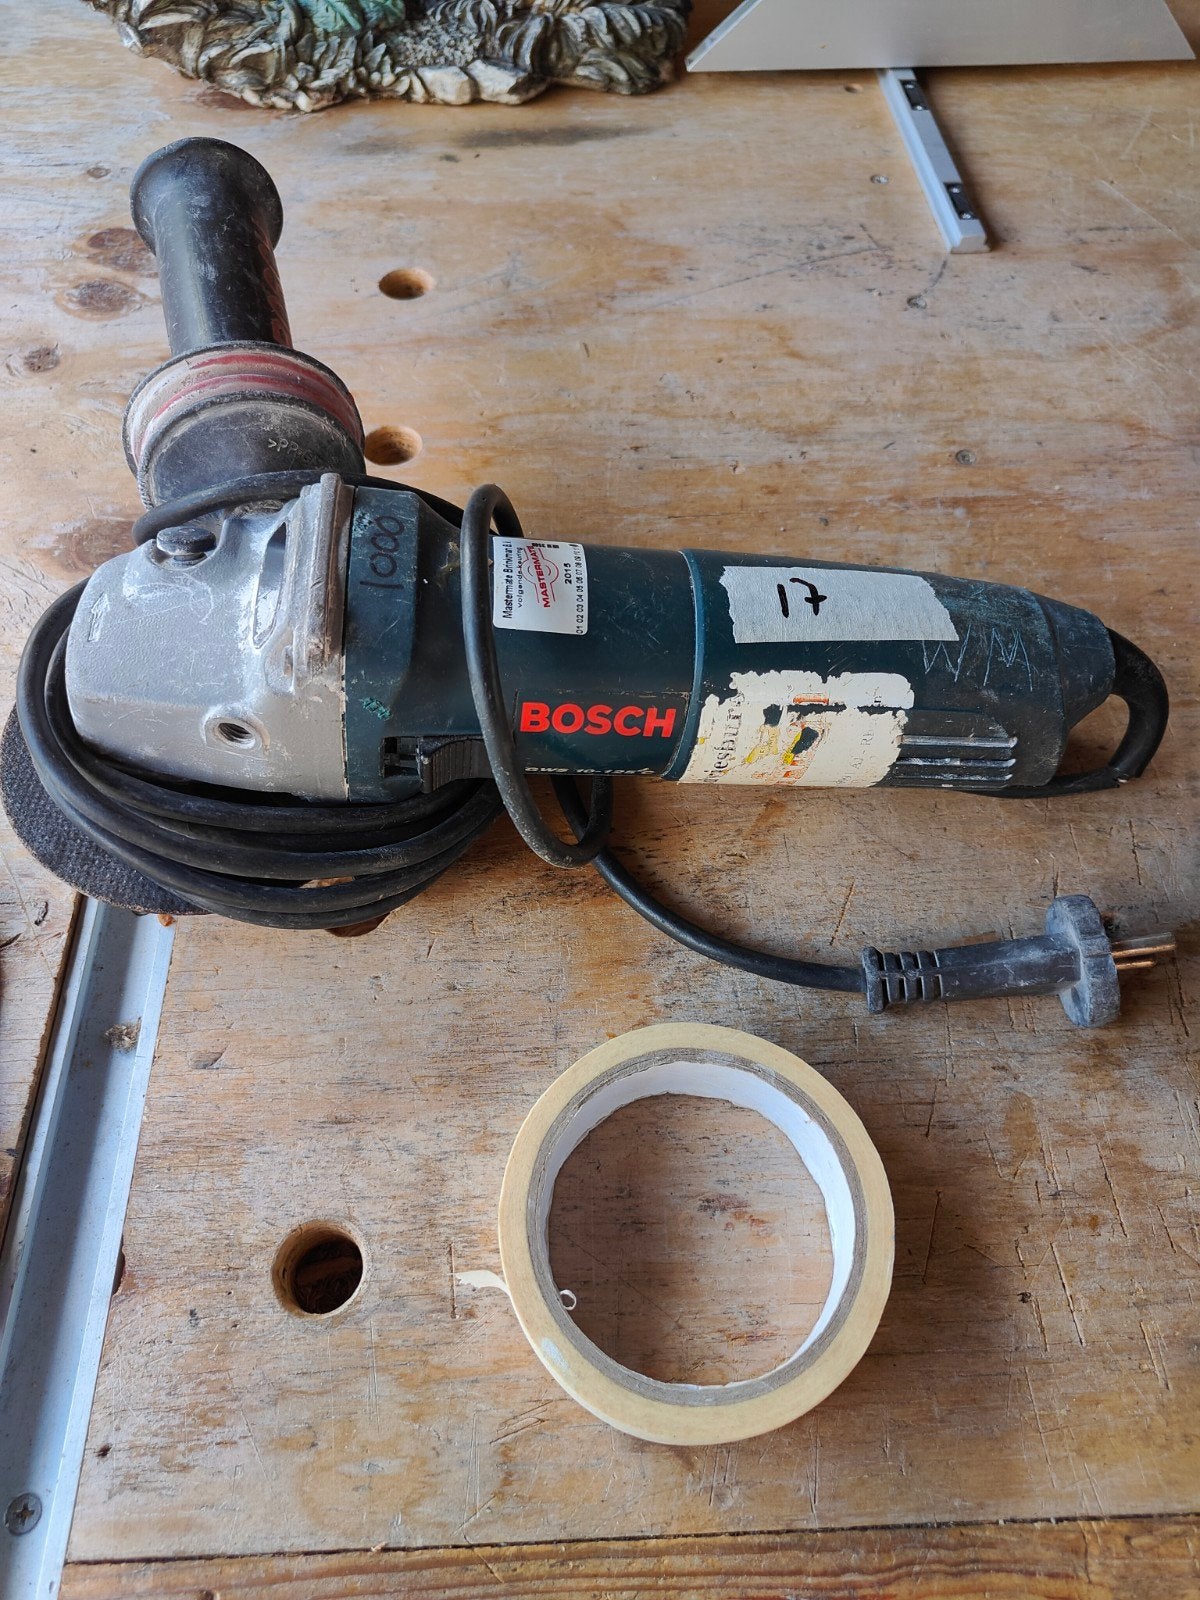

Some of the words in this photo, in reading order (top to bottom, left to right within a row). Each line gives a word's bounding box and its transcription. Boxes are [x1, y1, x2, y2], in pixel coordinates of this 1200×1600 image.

[358, 515, 405, 592] 1000
[503, 550, 513, 573] Brinkman
[516, 547, 524, 569] keuring
[526, 545, 551, 608] MASTERMATE
[563, 562, 572, 584] 2015
[576, 576, 584, 584] 06
[502, 574, 513, 619] Mastermate
[516, 570, 524, 608] volgende
[576, 585, 584, 593] 05
[576, 594, 584, 603] 04
[776, 577, 828, 619] 17
[576, 604, 584, 613] 03
[576, 614, 584, 623] 02
[519, 701, 677, 738] BOSCH
